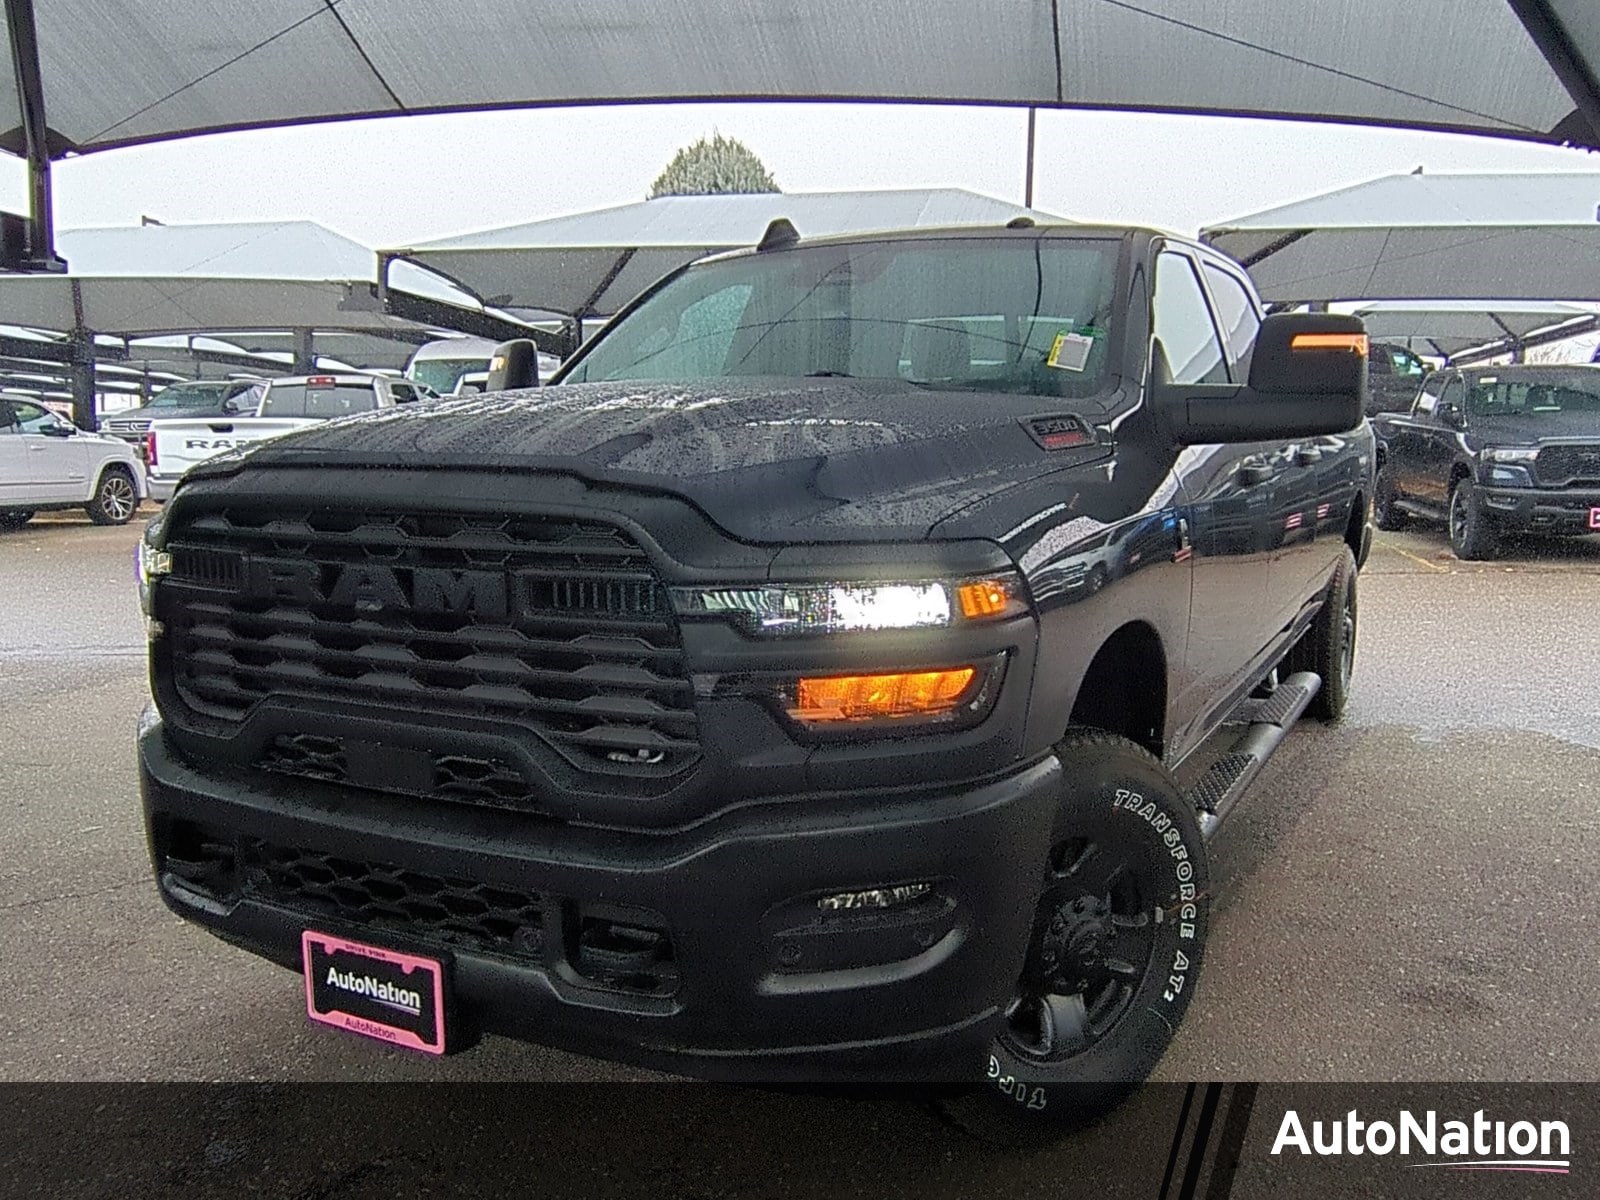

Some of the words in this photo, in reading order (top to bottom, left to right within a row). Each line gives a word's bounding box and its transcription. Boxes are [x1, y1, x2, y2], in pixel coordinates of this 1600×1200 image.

[1033, 419, 1079, 435] 3500
[243, 555, 509, 614] RAM
[1113, 788, 1197, 939] TRANSFORCE
[326, 967, 420, 1008] AutoNation
[344, 1017, 396, 1039] AutoNation
